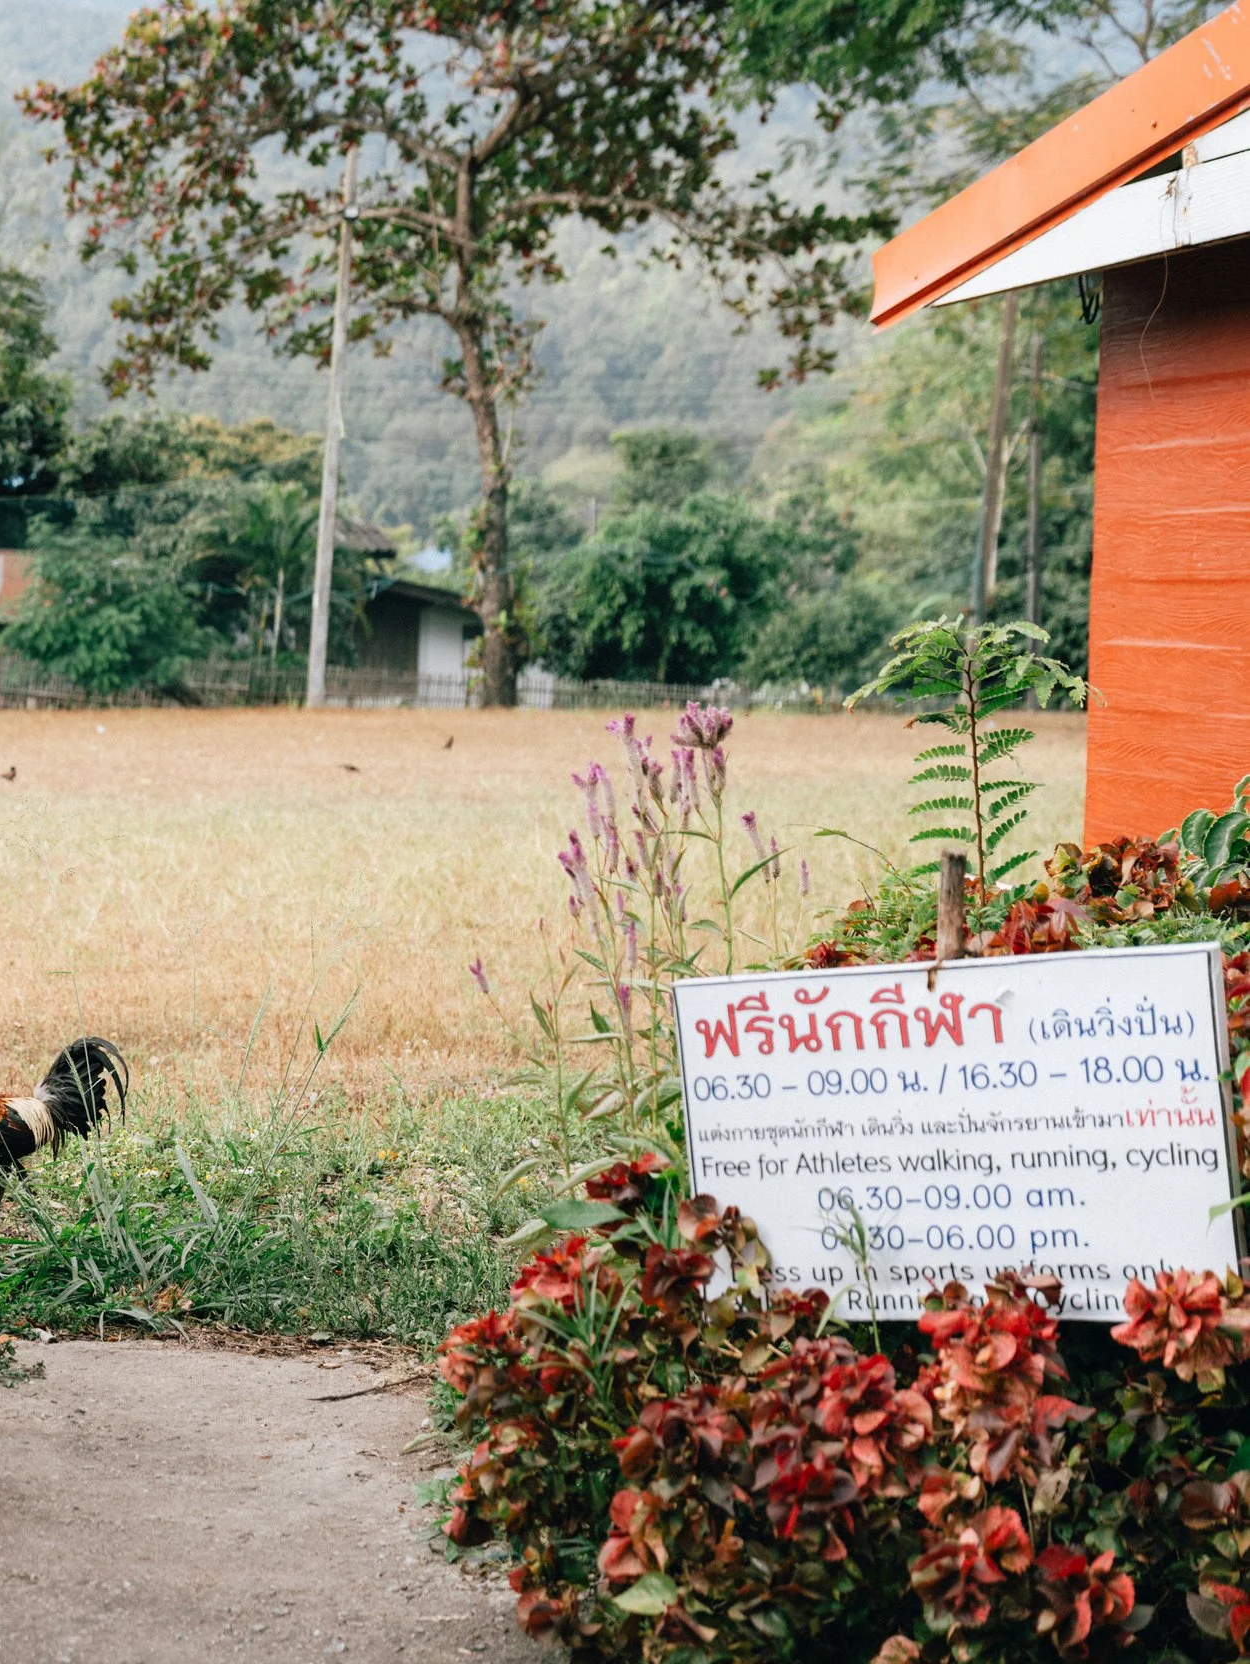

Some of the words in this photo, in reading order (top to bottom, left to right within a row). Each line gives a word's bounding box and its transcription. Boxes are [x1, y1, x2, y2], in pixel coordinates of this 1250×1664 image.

[695, 983, 1004, 1058] ฟรีนักกีฬา
[694, 1073, 771, 1101] 06.30
[807, 1068, 887, 1096] 09.00
[958, 1060, 1038, 1090] 16.30
[1080, 1055, 1163, 1084] 18.00
[701, 1156, 750, 1177] Free
[758, 1153, 788, 1180] for
[795, 1149, 892, 1176] Athletes
[898, 1146, 1002, 1176] walking,
[1011, 1144, 1117, 1172] running,
[1126, 1142, 1219, 1172] cycling
[817, 1184, 1012, 1211] 06.30-09.00
[1026, 1187, 1087, 1209] am.
[821, 1223, 1015, 1251] 030-06.00
[1031, 1229, 1090, 1255] pm.
[812, 1267, 844, 1287] up
[889, 1262, 975, 1285] sports
[1122, 1258, 1184, 1282] onl
[848, 1288, 926, 1311] Runni
[1034, 1286, 1127, 1316] Cyclin
